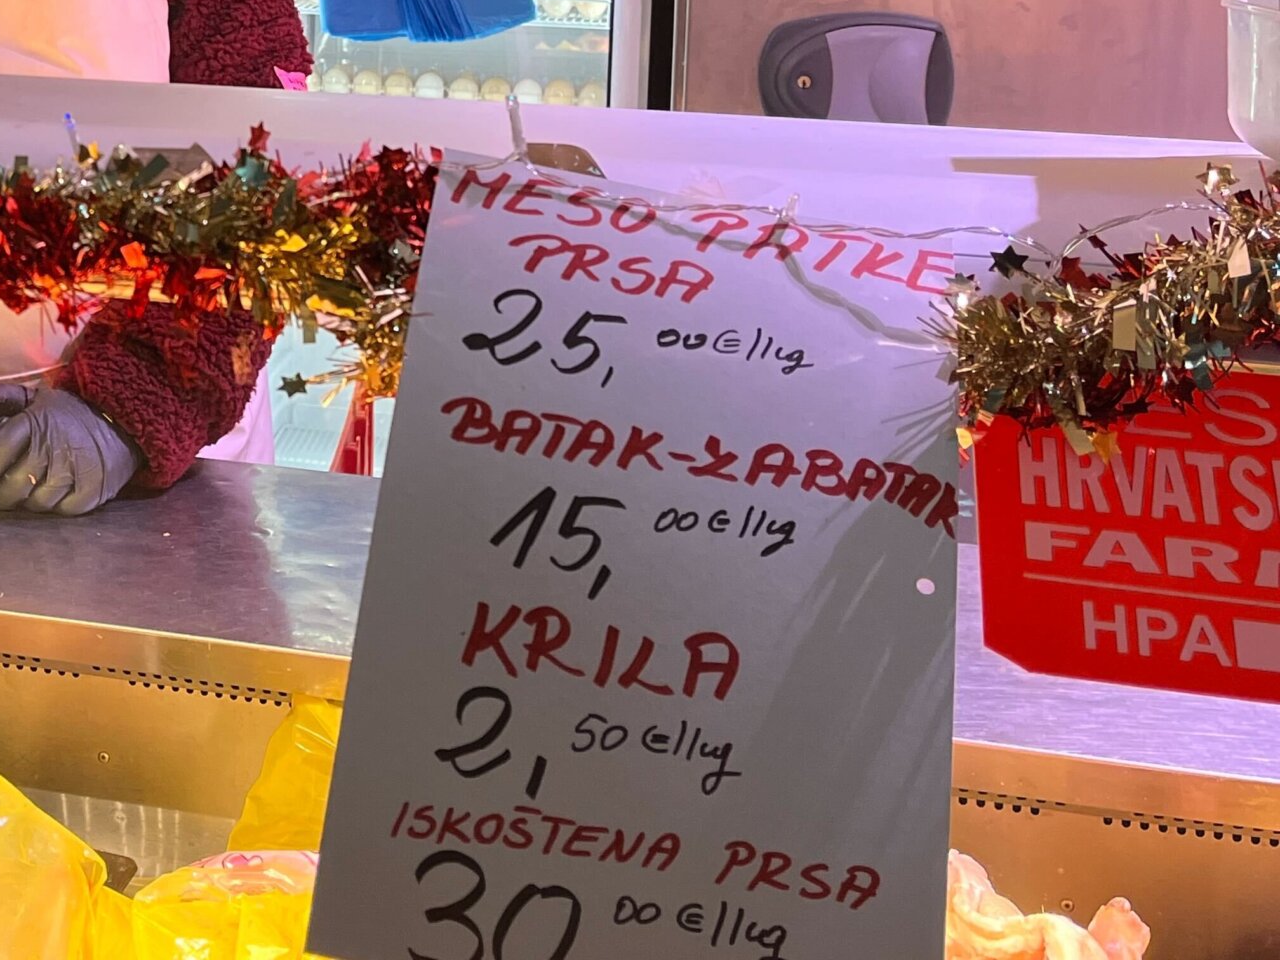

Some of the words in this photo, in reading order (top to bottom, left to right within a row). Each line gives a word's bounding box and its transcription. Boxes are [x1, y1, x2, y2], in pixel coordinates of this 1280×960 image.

[450, 168, 656, 234] MESO
[691, 209, 956, 297] PATKE
[508, 234, 716, 305] PRSA
[462, 288, 628, 388] 25,
[1018, 435, 1280, 532] HRVATS
[489, 486, 626, 600] 15,
[461, 601, 740, 701] KRILA
[1082, 600, 1233, 668] HPA
[390, 802, 681, 872] ISKOŠTENA
[714, 840, 882, 910] PRSA
